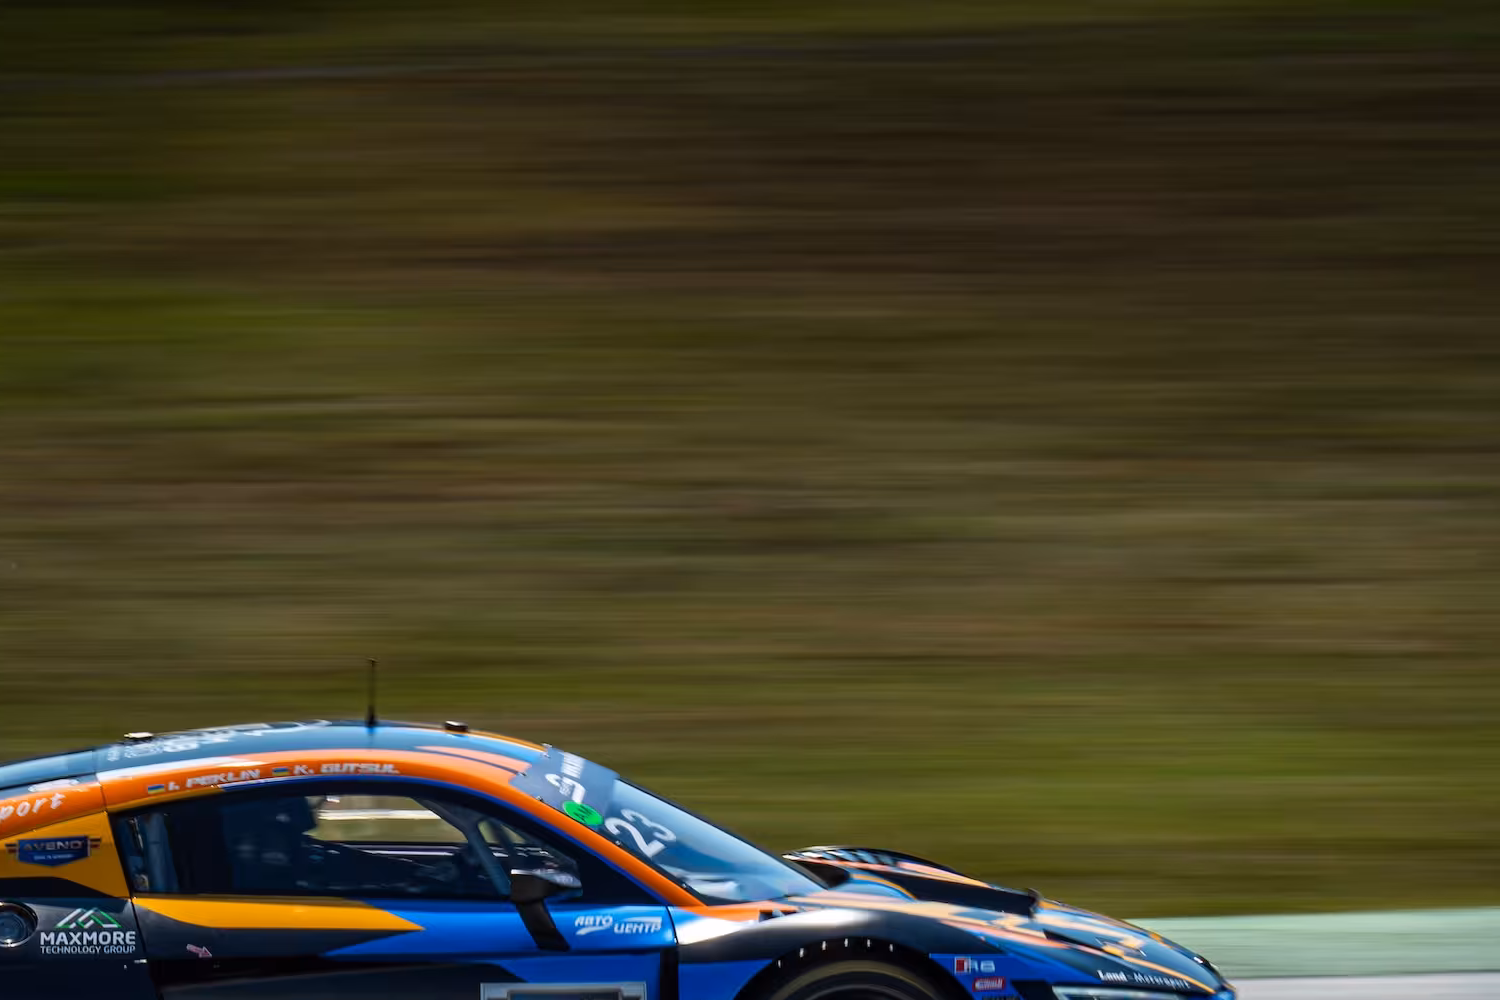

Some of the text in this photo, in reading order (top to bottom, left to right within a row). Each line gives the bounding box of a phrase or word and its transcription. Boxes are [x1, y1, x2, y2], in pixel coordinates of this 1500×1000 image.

[604, 808, 677, 858] 23
[40, 931, 136, 946] MAXMORE
[40, 945, 136, 954] TECHNOLOGY GROUP
